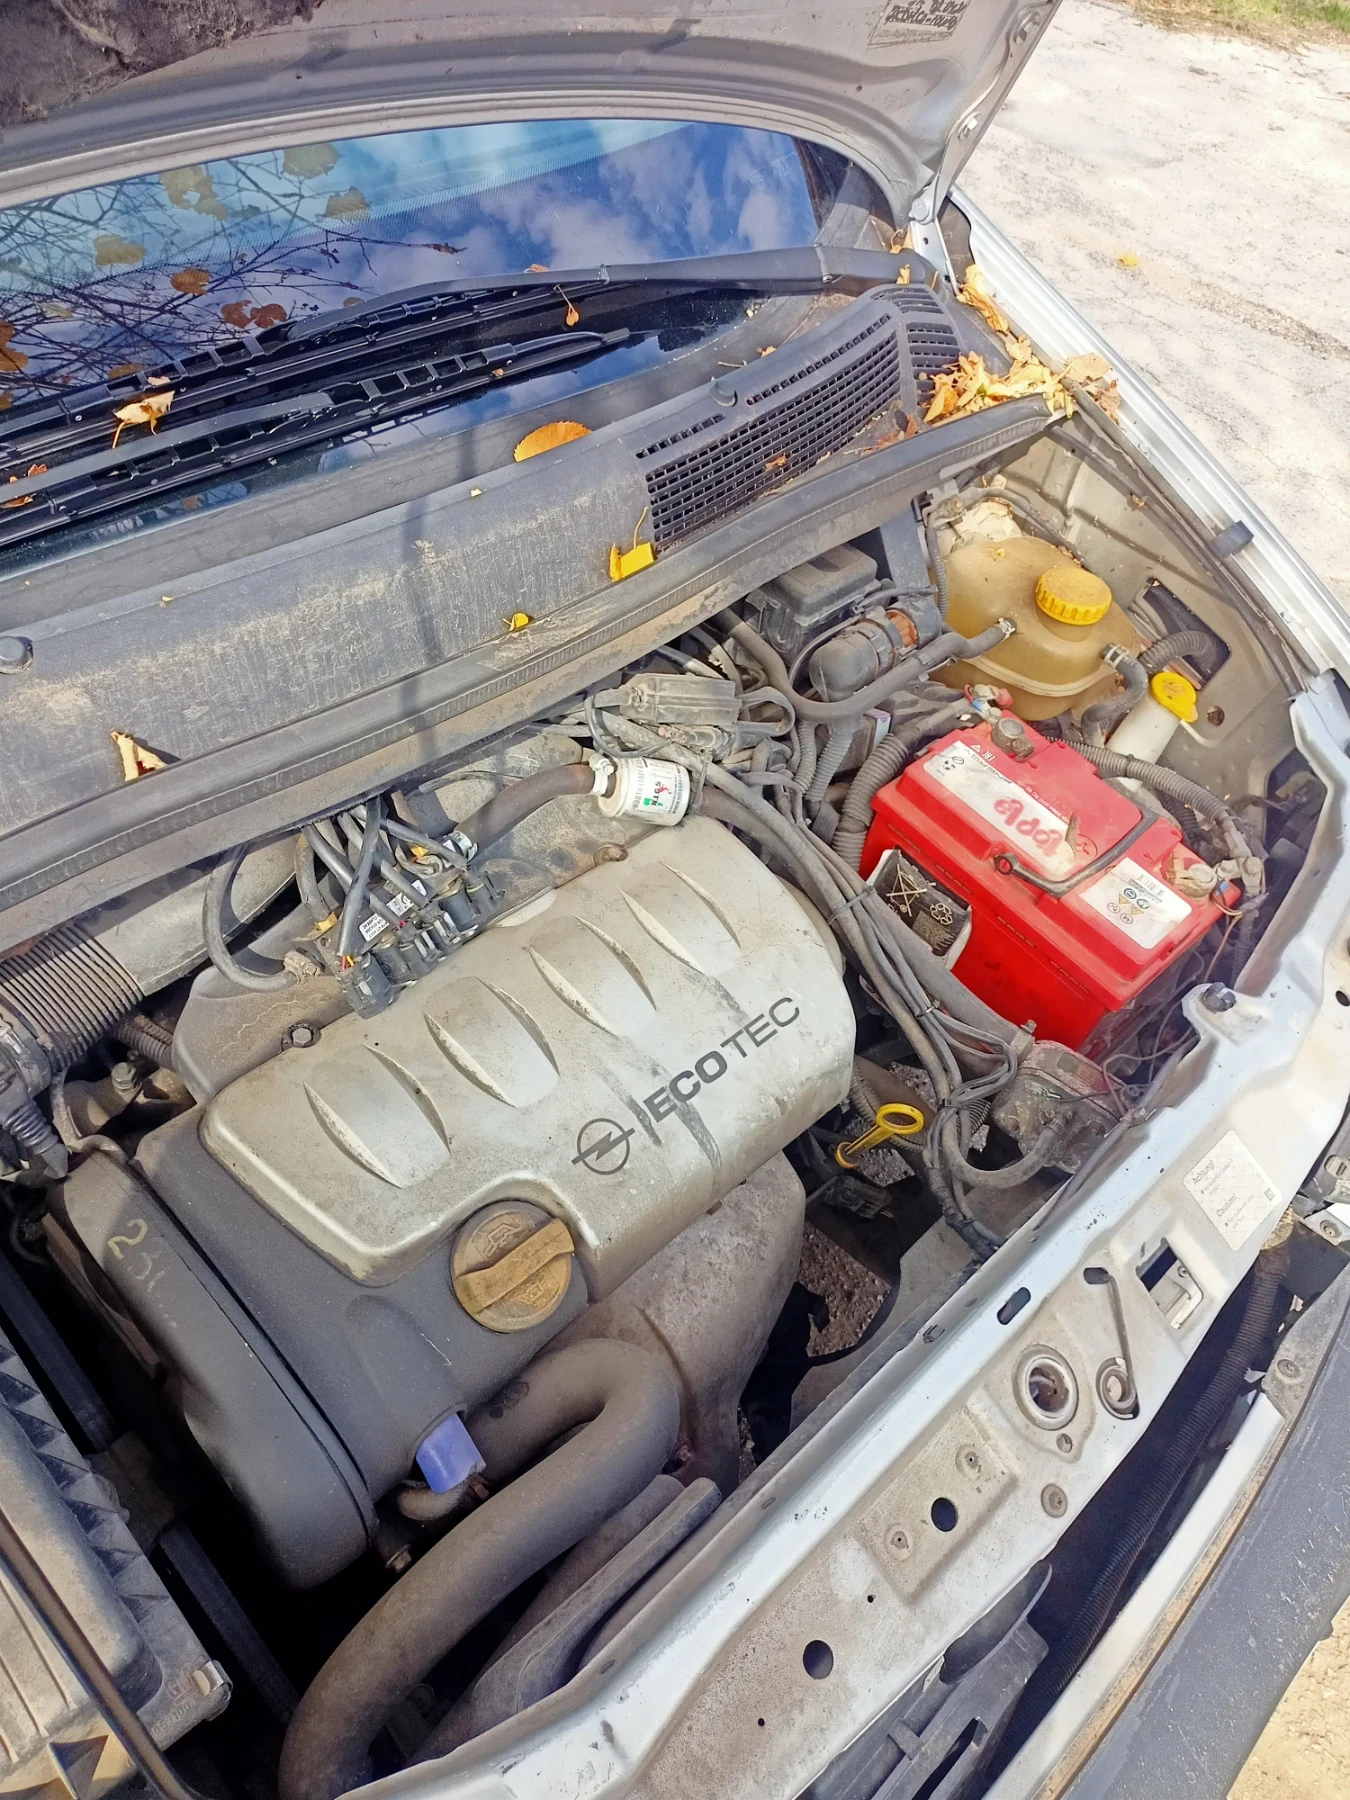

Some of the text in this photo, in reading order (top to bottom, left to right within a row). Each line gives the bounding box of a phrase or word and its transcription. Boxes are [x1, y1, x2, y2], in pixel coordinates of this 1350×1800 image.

[993, 797, 1063, 856] topla
[643, 997, 800, 1123] ECOTEC
[1192, 1160, 1215, 1185] Achtung!
[1216, 1193, 1238, 1217] Caution!
